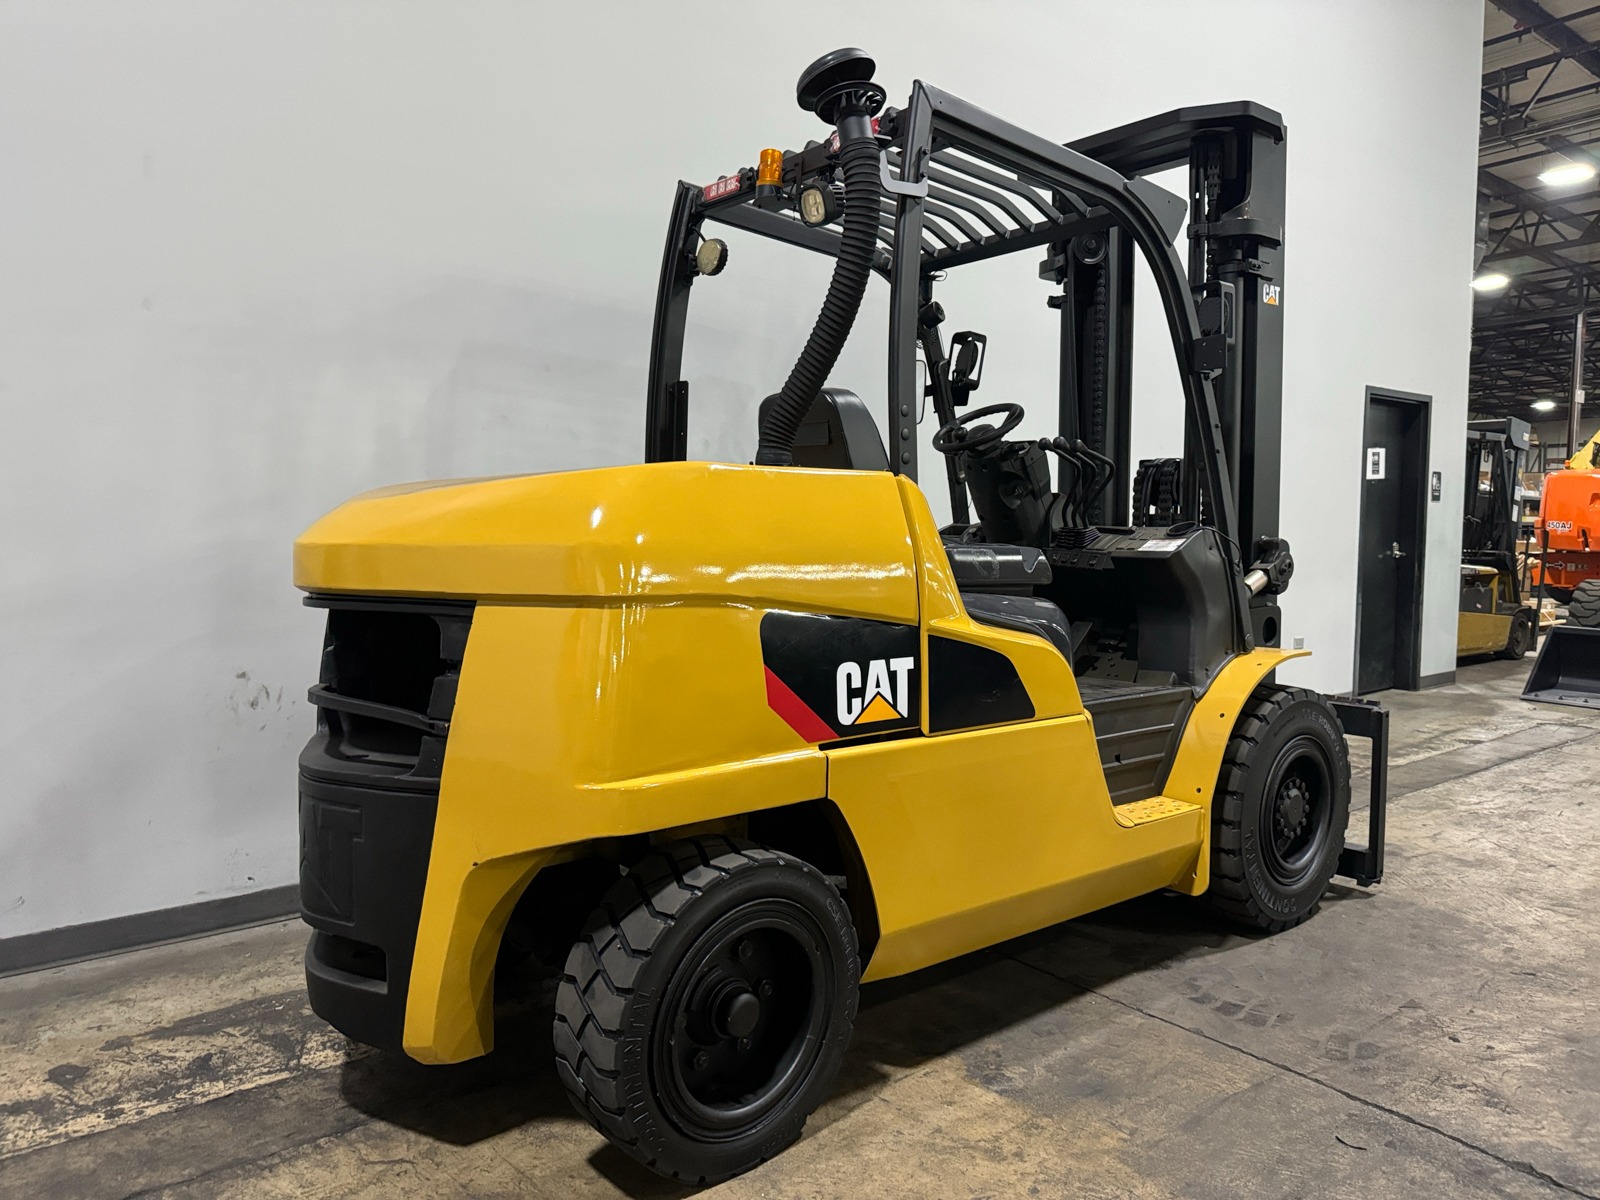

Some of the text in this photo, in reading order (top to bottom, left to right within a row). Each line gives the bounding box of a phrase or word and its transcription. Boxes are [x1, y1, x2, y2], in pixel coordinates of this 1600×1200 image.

[1262, 284, 1281, 306] CAT
[1546, 521, 1573, 530] 450AJ
[836, 656, 914, 726] CAT
